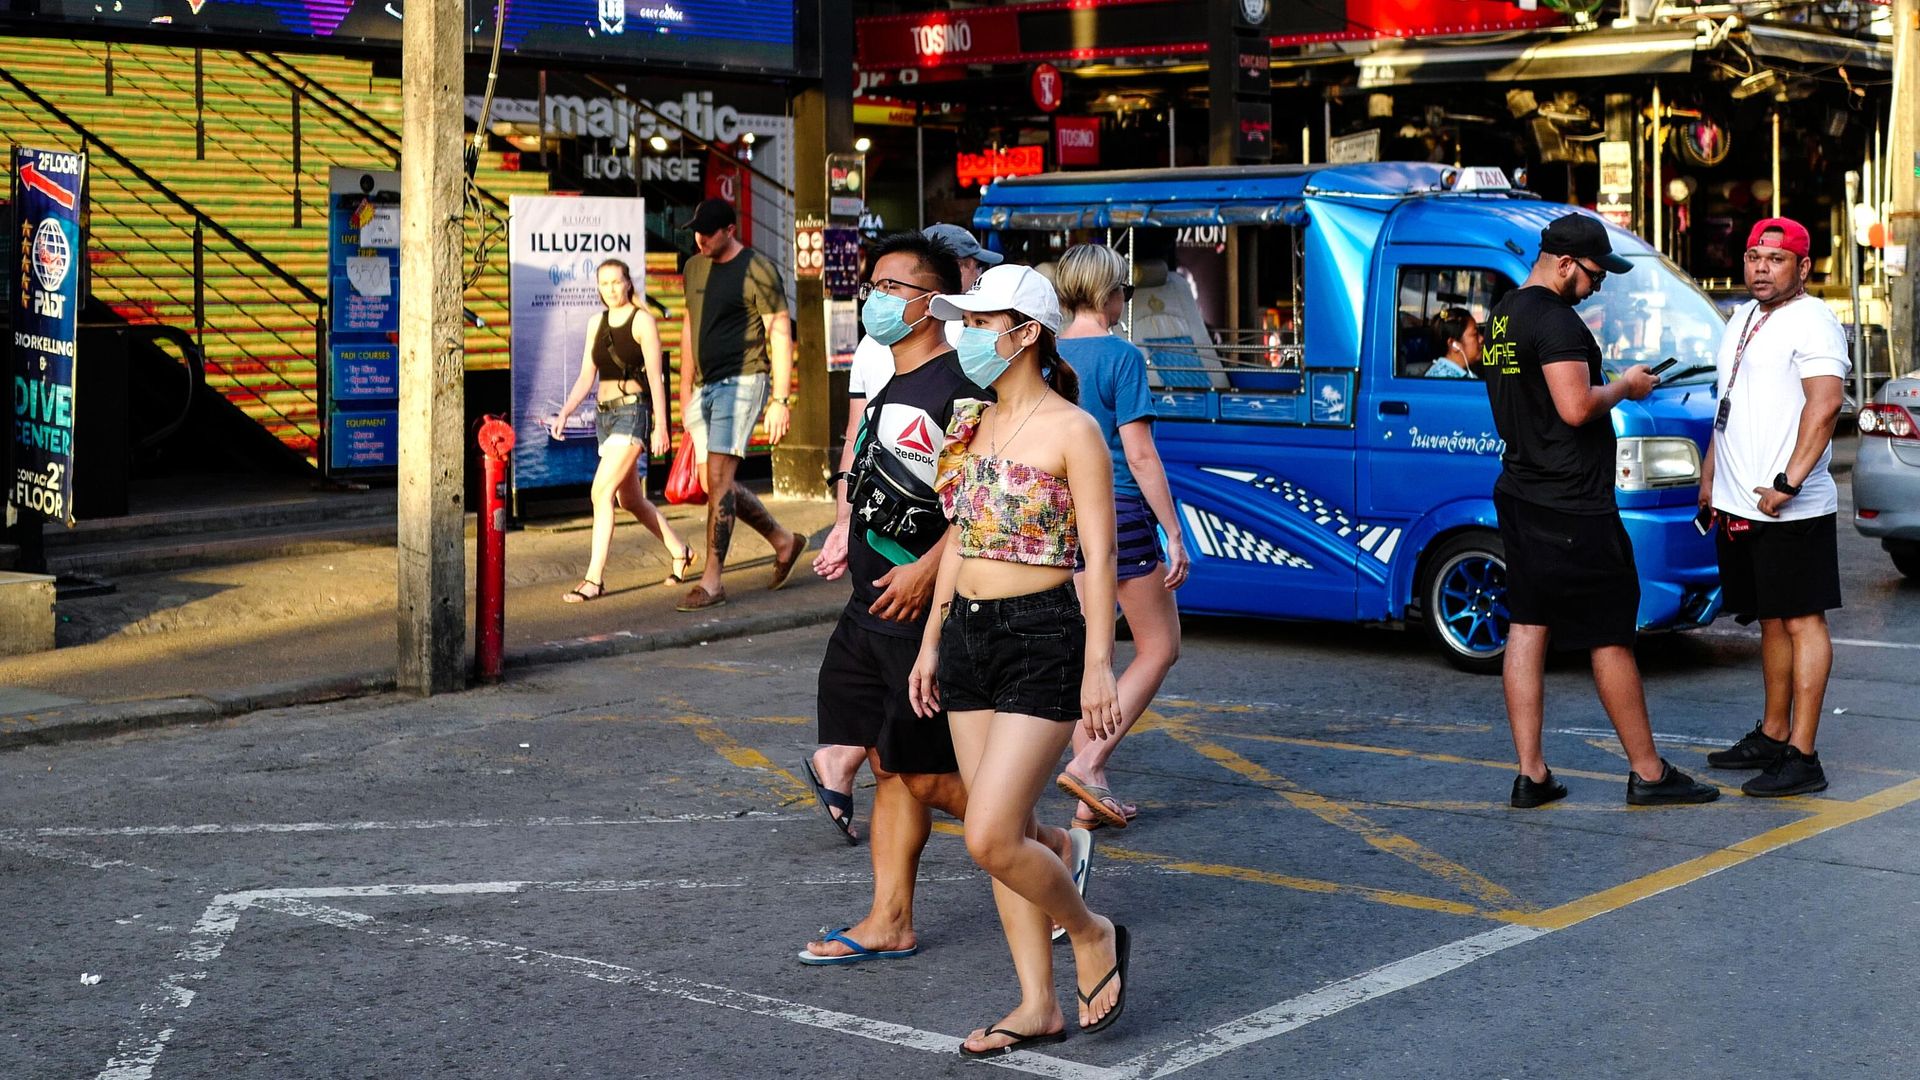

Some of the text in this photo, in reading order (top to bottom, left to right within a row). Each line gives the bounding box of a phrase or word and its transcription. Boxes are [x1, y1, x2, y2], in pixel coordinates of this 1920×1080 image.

[545, 84, 739, 149] majestic
[583, 154, 700, 182] LOUNGE
[1476, 170, 1506, 186] TAXI
[531, 232, 631, 252] ILLUZION
[34, 290, 66, 319] PADI
[15, 331, 74, 357] SNORKELLING
[15, 376, 72, 428] DIVE
[346, 418, 386, 428] EQUIPMENT
[15, 420, 70, 456] CENTER
[894, 447, 934, 467] Reebok
[16, 482, 63, 518] FLOOR
